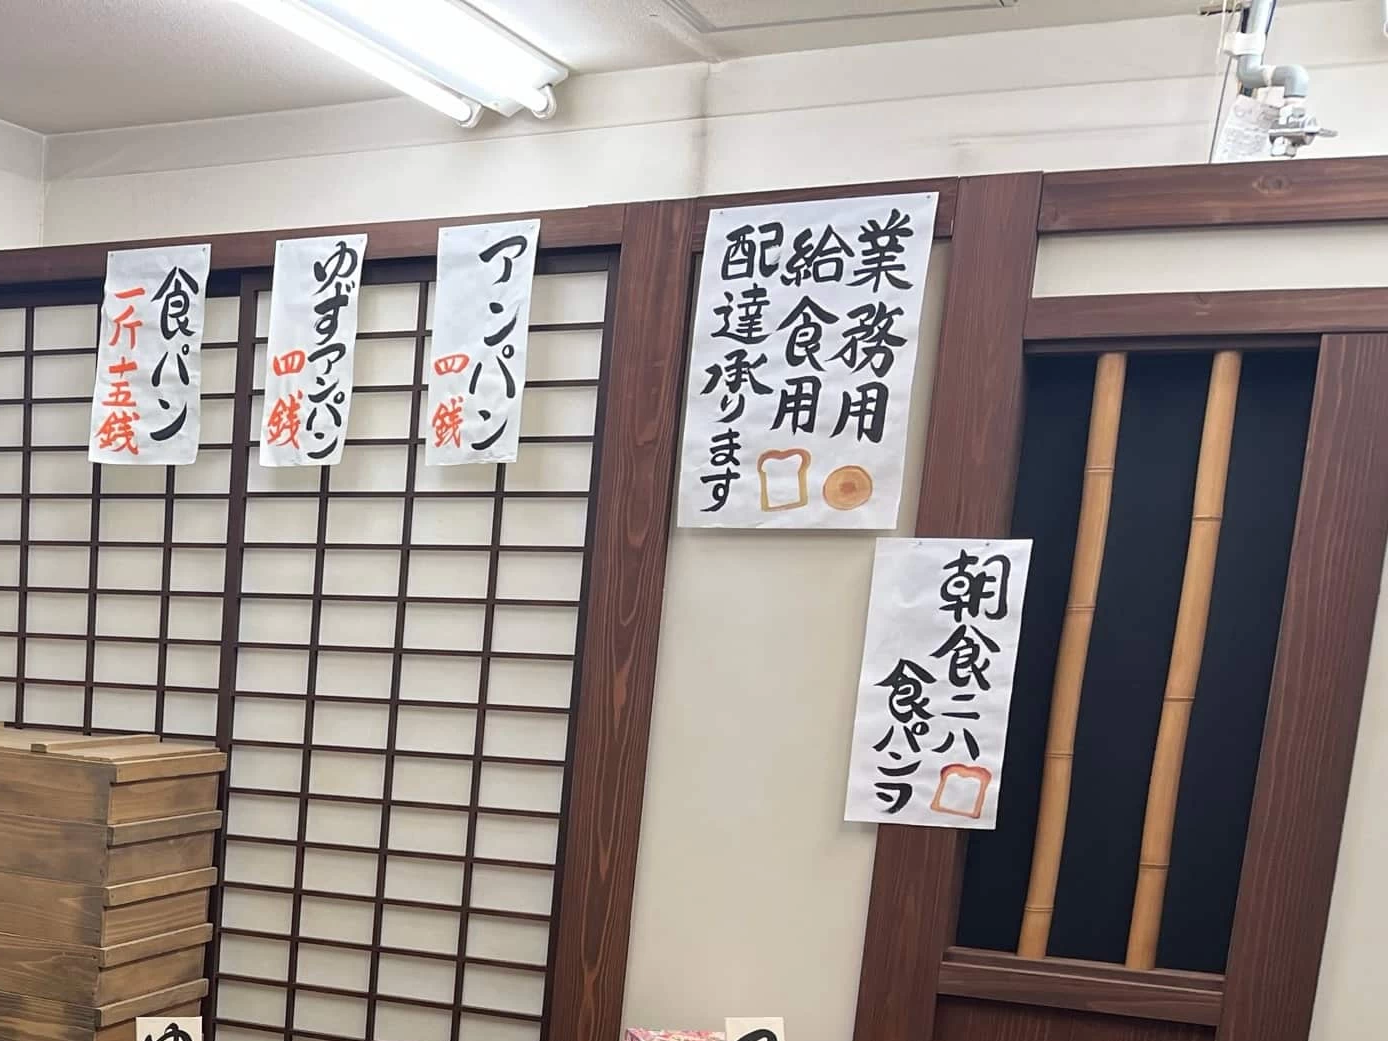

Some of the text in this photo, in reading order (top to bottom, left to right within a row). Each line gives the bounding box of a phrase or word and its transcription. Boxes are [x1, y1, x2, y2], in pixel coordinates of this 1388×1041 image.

[150, 266, 200, 442] 食パン
[306, 240, 358, 460] ゆずアンパン
[469, 235, 527, 451] アンパン
[700, 222, 786, 512] 配達承ります
[771, 224, 855, 435] 給食用
[827, 209, 913, 443] 業務用
[874, 659, 937, 815] 食パンヲ
[929, 549, 1011, 760] 朝食ニハ
